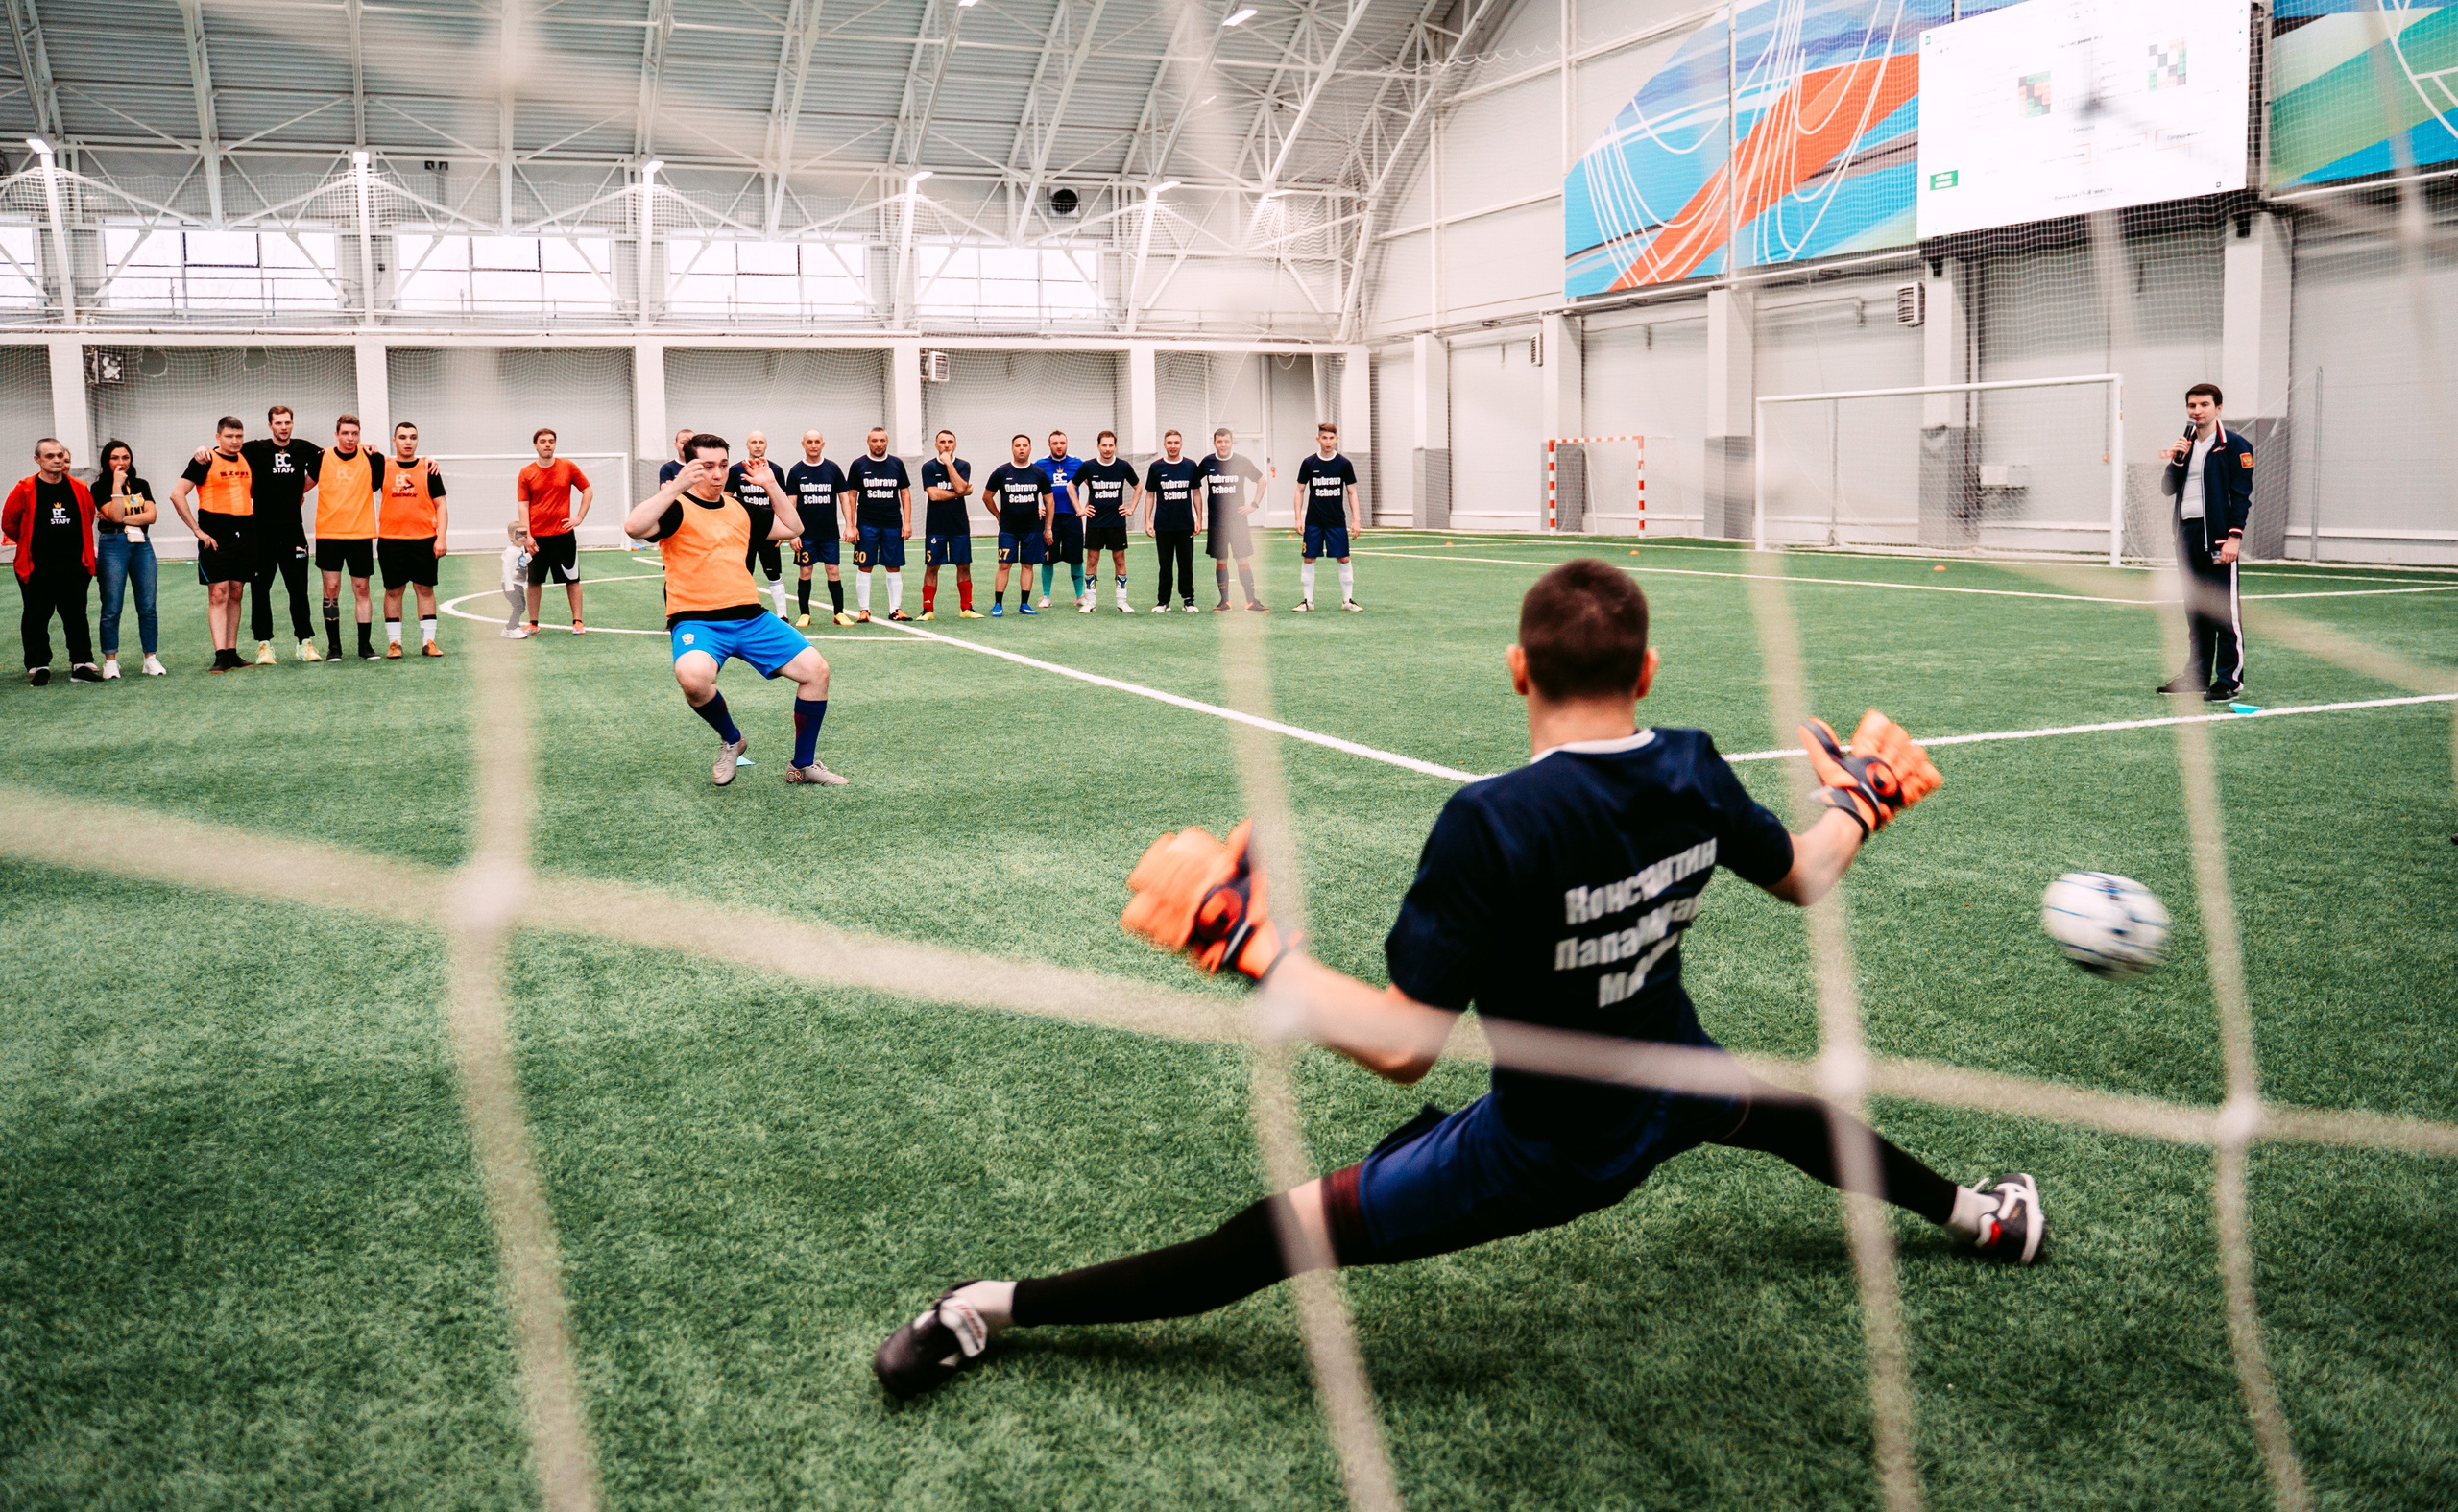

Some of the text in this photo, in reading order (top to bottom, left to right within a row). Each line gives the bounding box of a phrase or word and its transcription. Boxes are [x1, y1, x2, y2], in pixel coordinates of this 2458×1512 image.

[275, 453, 292, 467] BC
[863, 478, 897, 488] Dubrava
[1209, 474, 1239, 483] Dubrava
[800, 483, 831, 492] Dubrava
[1004, 483, 1038, 492] Dubrava
[1212, 486, 1236, 494] School
[1315, 488, 1340, 496] School
[867, 490, 894, 498] School
[1009, 493, 1035, 503] School
[1095, 490, 1119, 499] School
[1164, 491, 1187, 500] School
[804, 494, 830, 504] School
[796, 550, 809, 563] 13
[854, 550, 866, 563] 30
[999, 548, 1010, 561] 27
